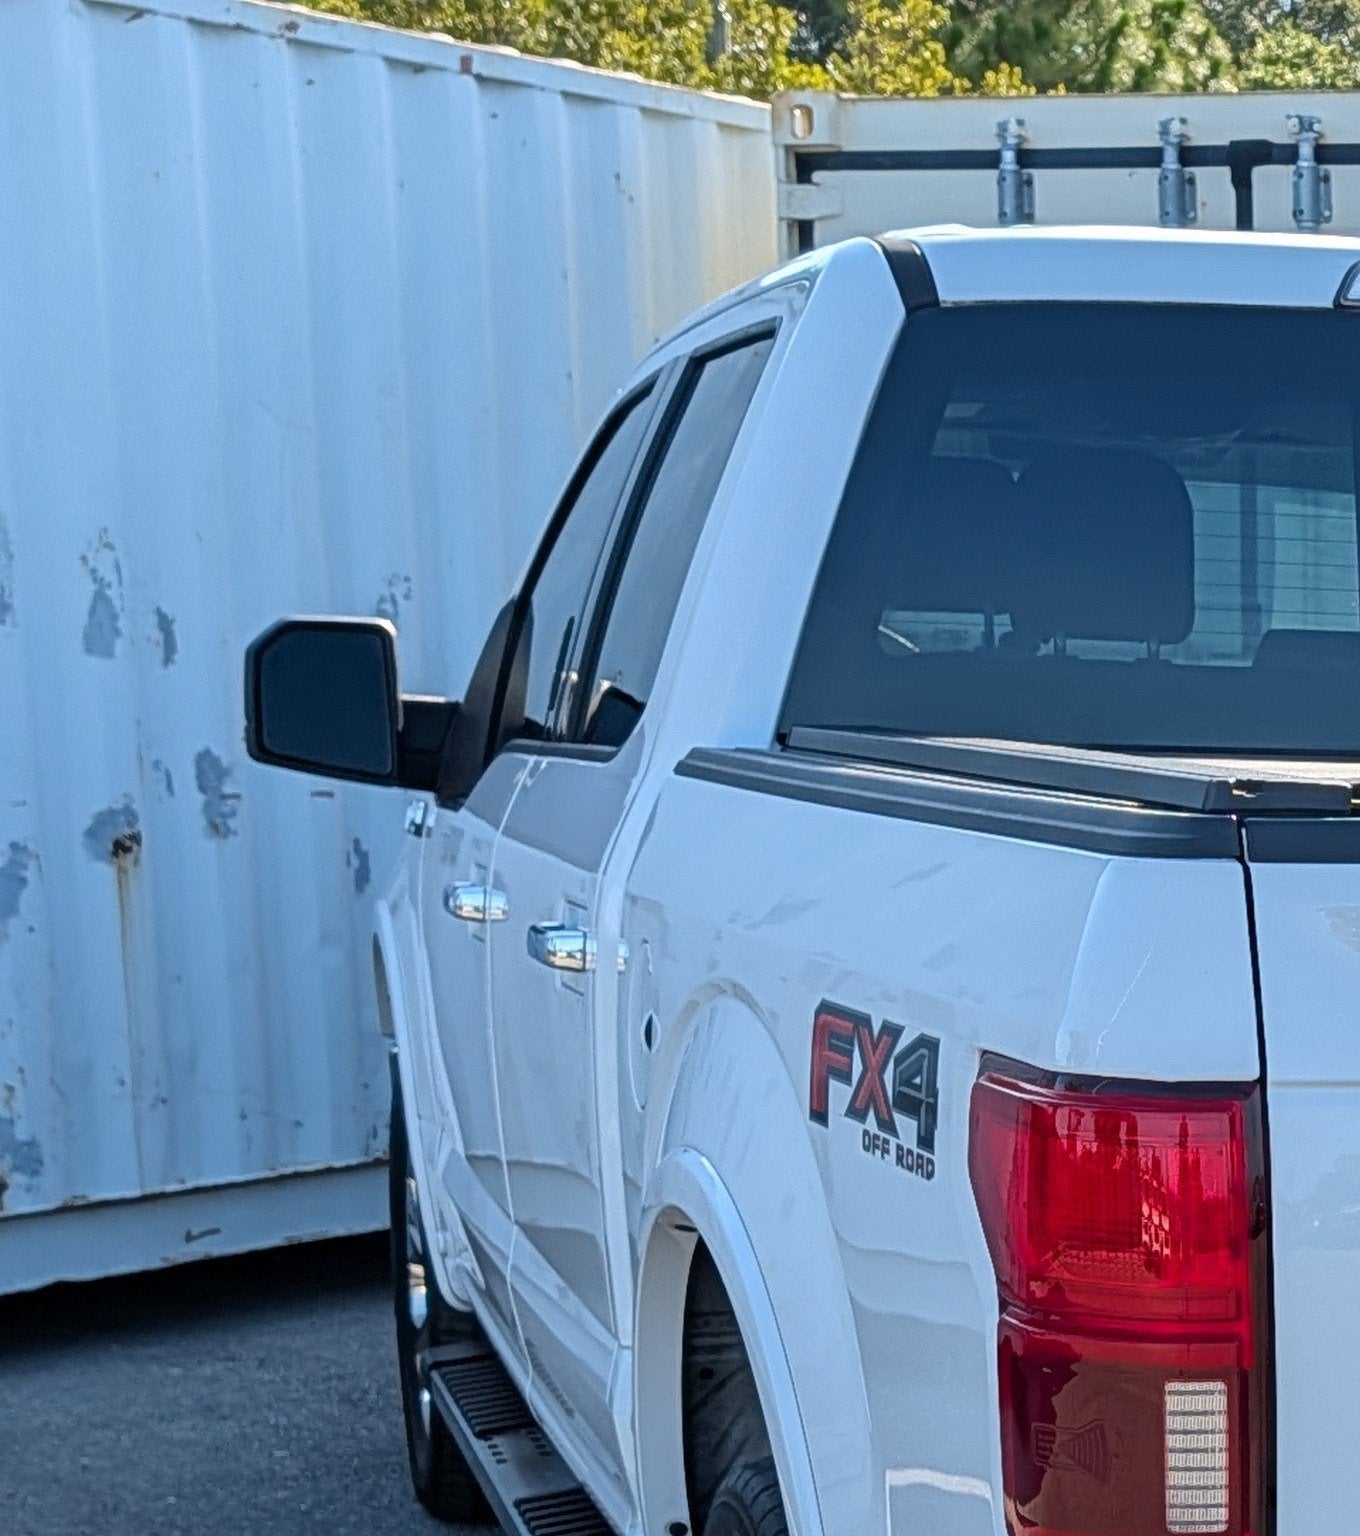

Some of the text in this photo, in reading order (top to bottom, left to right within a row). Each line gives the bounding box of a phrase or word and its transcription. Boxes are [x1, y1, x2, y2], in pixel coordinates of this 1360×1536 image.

[808, 997, 941, 1157] FX4
[862, 1128, 936, 1181] OFF ROAD
